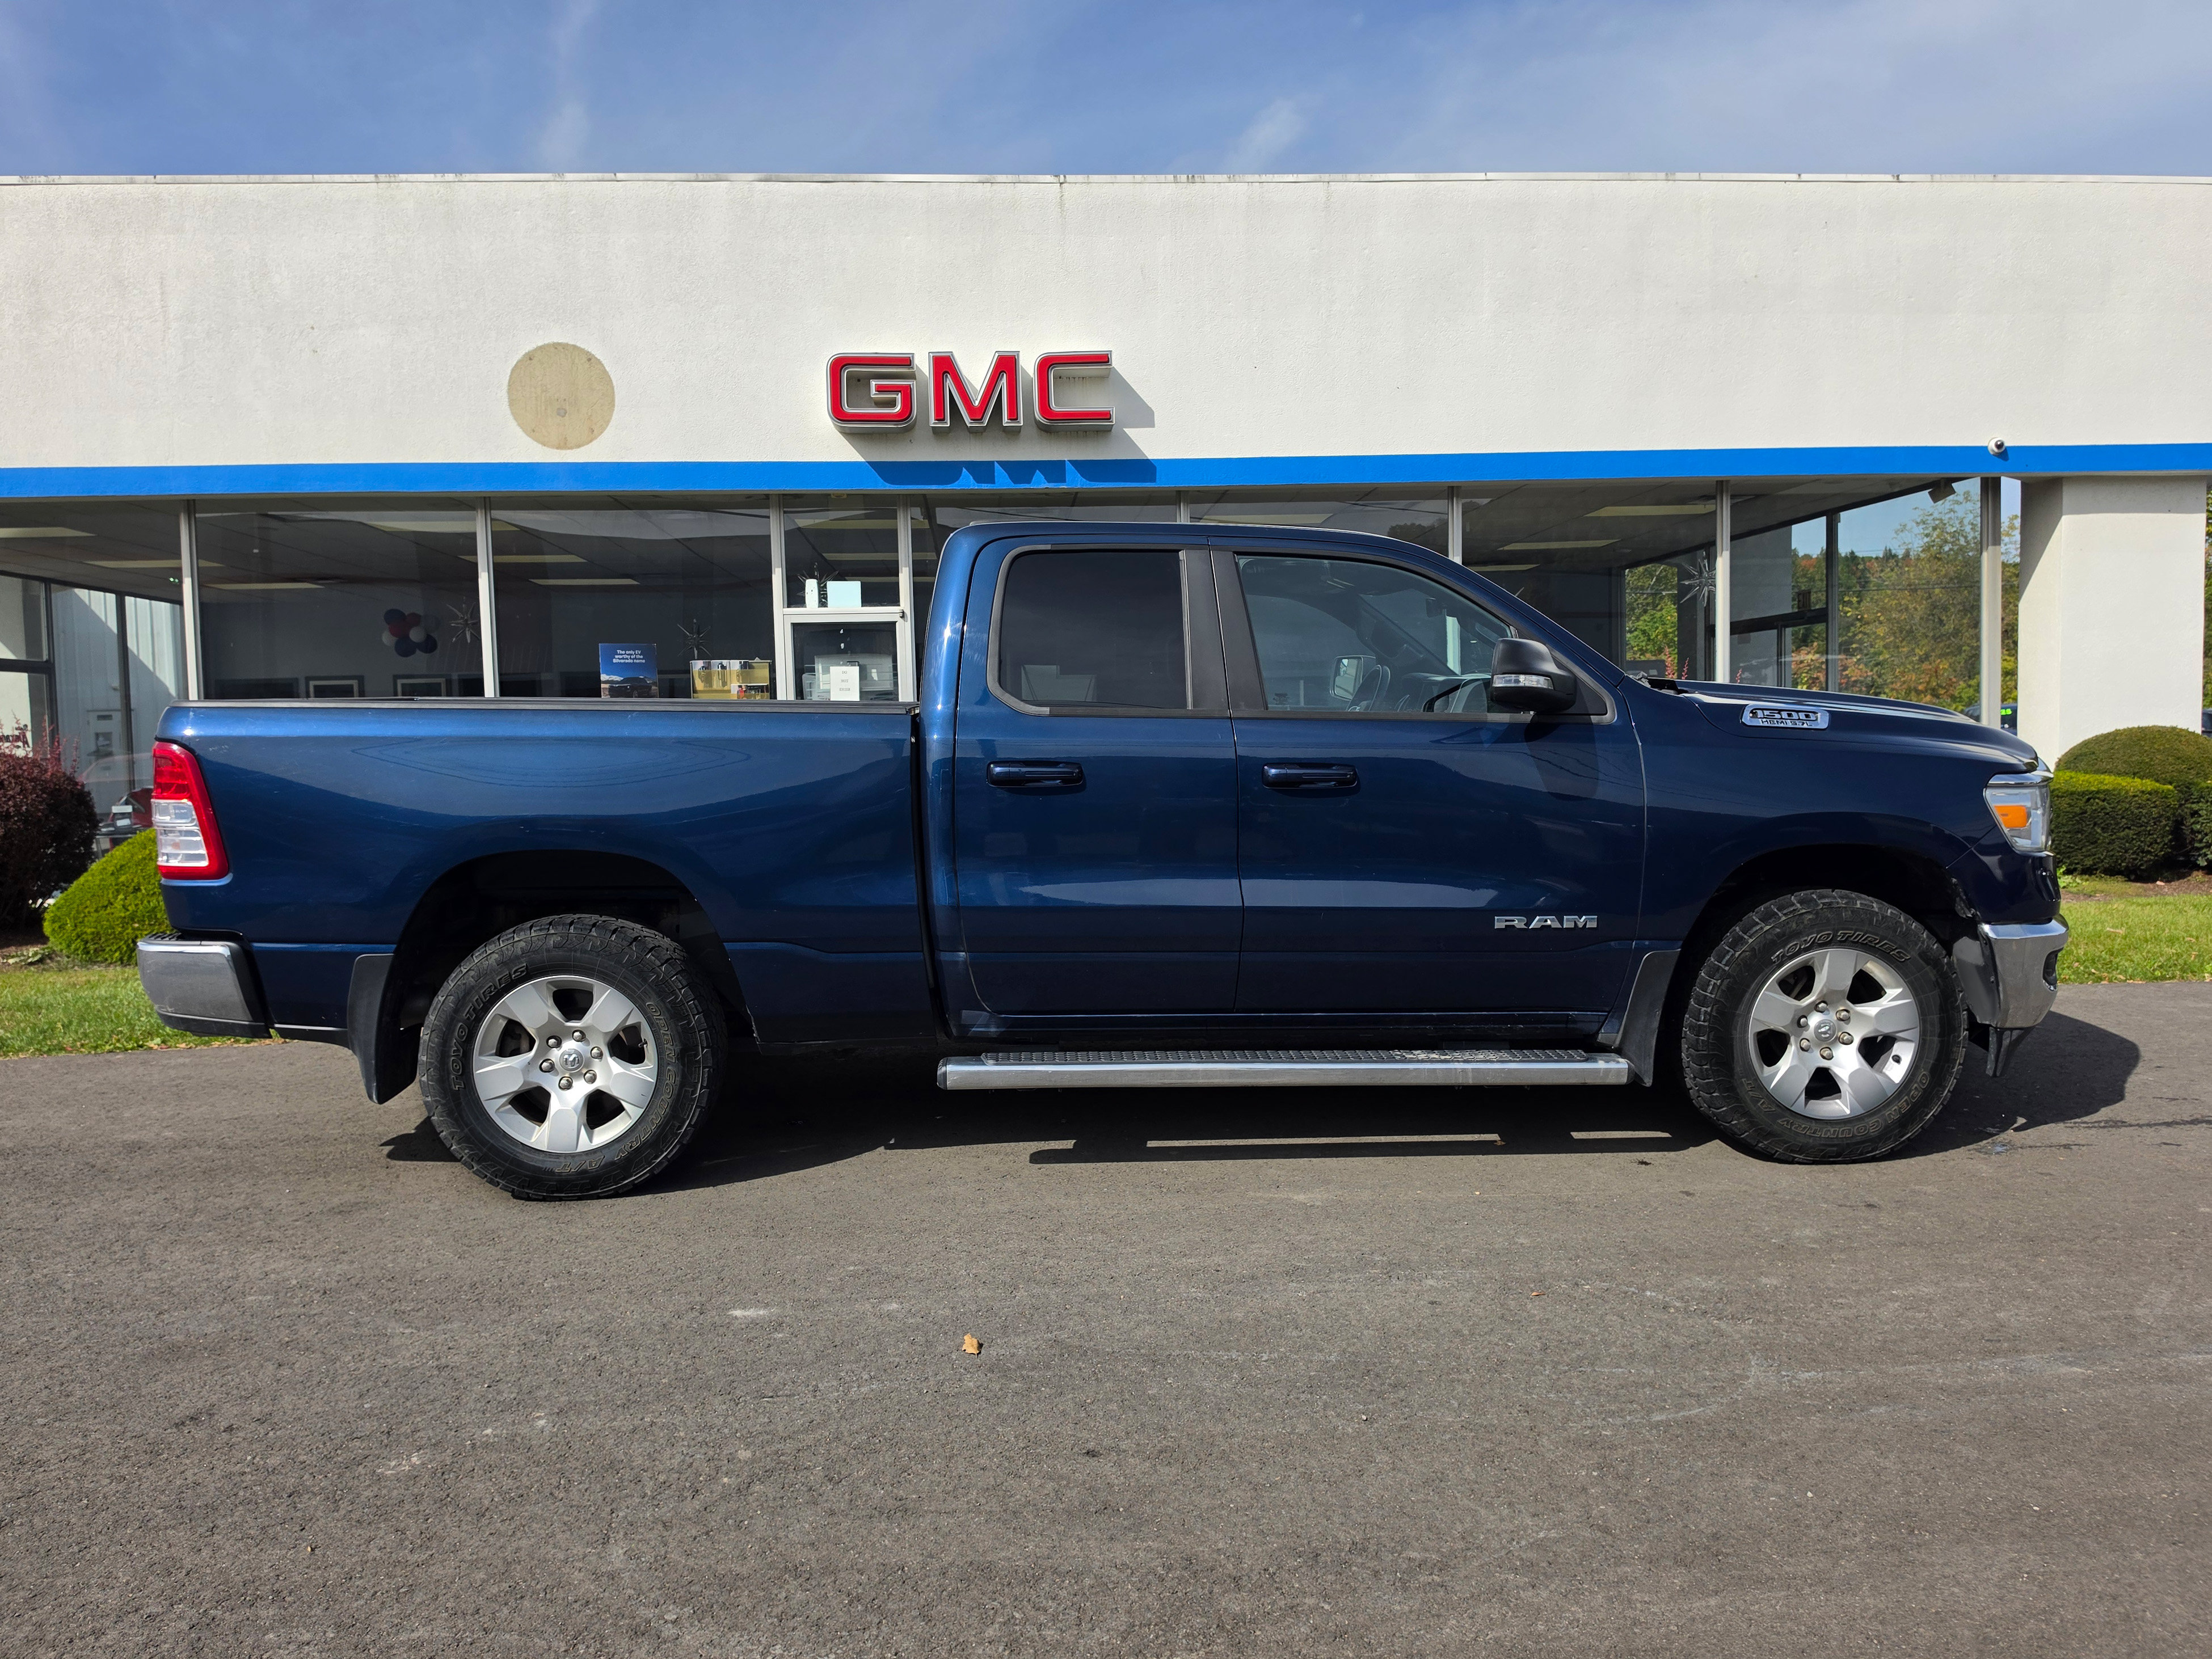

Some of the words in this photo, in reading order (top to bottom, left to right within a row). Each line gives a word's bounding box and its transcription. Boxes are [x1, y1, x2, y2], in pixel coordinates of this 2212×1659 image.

[827, 351, 1115, 429] GMC
[1751, 710, 1817, 721] 1500
[1494, 915, 1598, 929] RAM
[1771, 931, 1833, 963] TOYO
[1837, 930, 1911, 961] TIRES
[450, 1023, 469, 1091] TOYO
[465, 963, 527, 1020] TIRES
[646, 1002, 676, 1063] OPEN
[1742, 1078, 1776, 1112] A/T
[1885, 1071, 1930, 1124] OPEN
[614, 1066, 677, 1161] COUNTRY
[1777, 1117, 1882, 1138] COUNTRY
[555, 1155, 605, 1173] A/T
